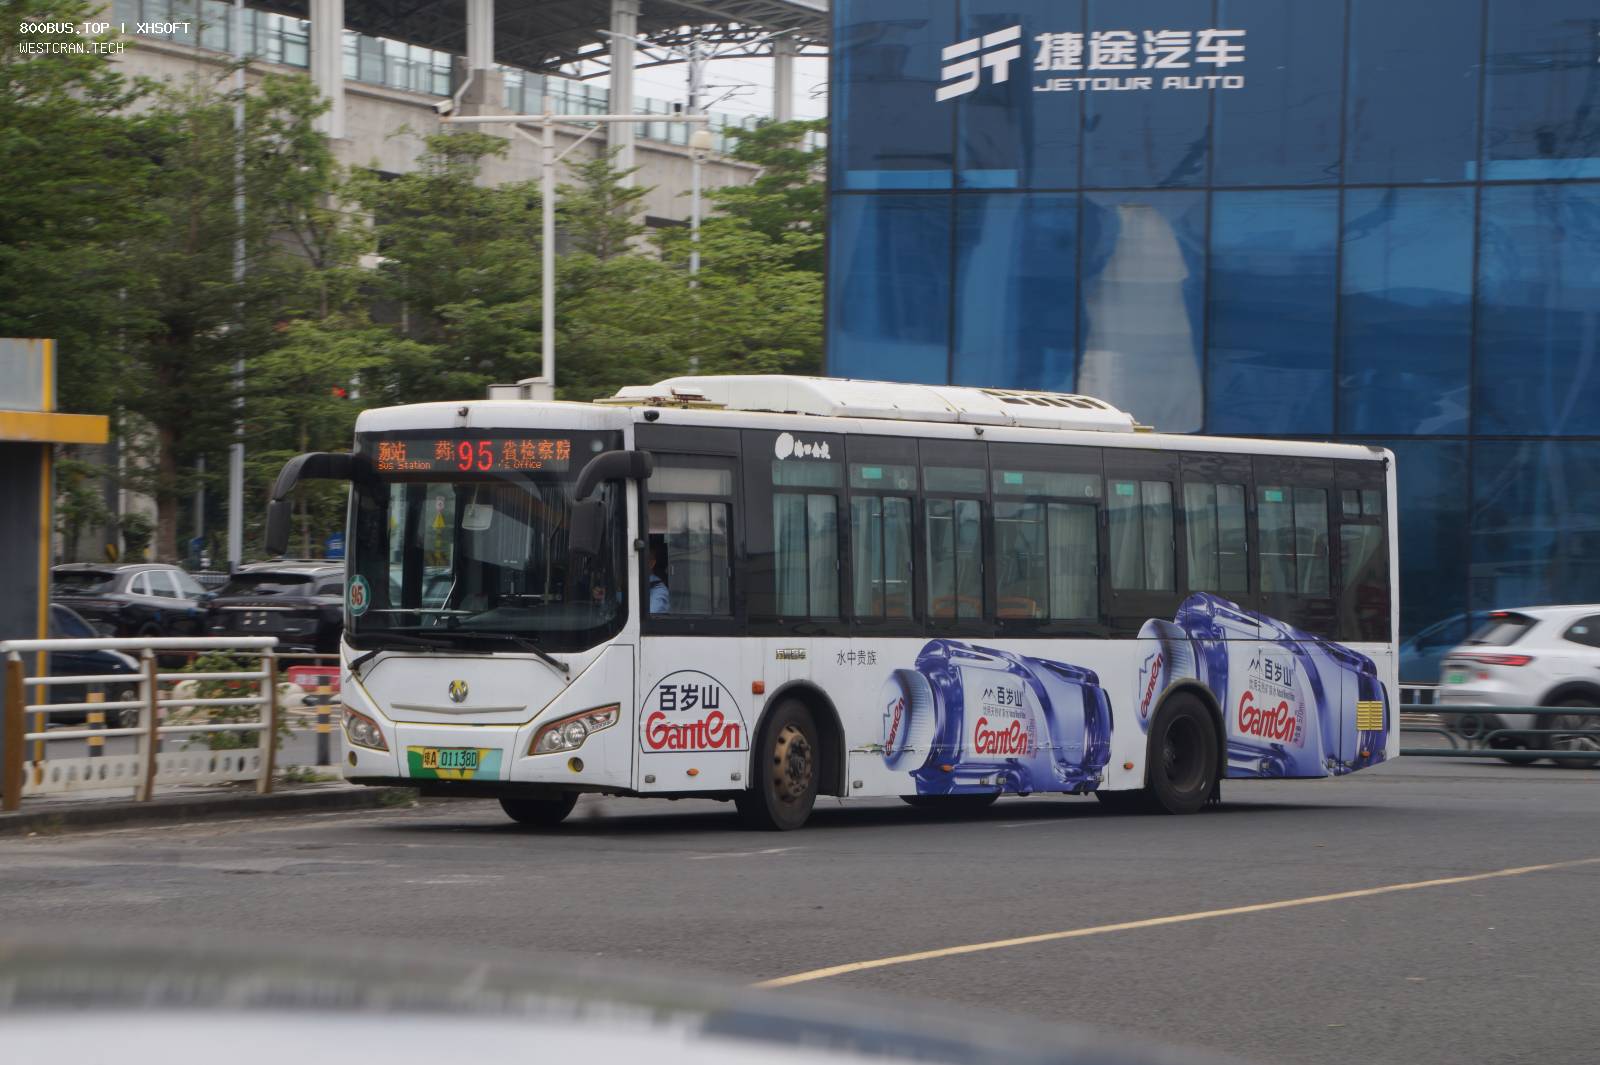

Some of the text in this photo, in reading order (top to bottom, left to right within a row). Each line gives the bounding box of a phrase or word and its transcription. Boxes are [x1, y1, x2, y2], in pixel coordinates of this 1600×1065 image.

[1033, 29, 1248, 71] 捷途汽车
[1032, 75, 1246, 92] JETOUR AUTO
[457, 440, 494, 472] 95
[351, 584, 364, 606] 95
[836, 649, 877, 666] 水中贵族
[1264, 658, 1292, 687] 百岁山
[659, 683, 720, 711] 百岁山
[997, 686, 1023, 707] 百岁山
